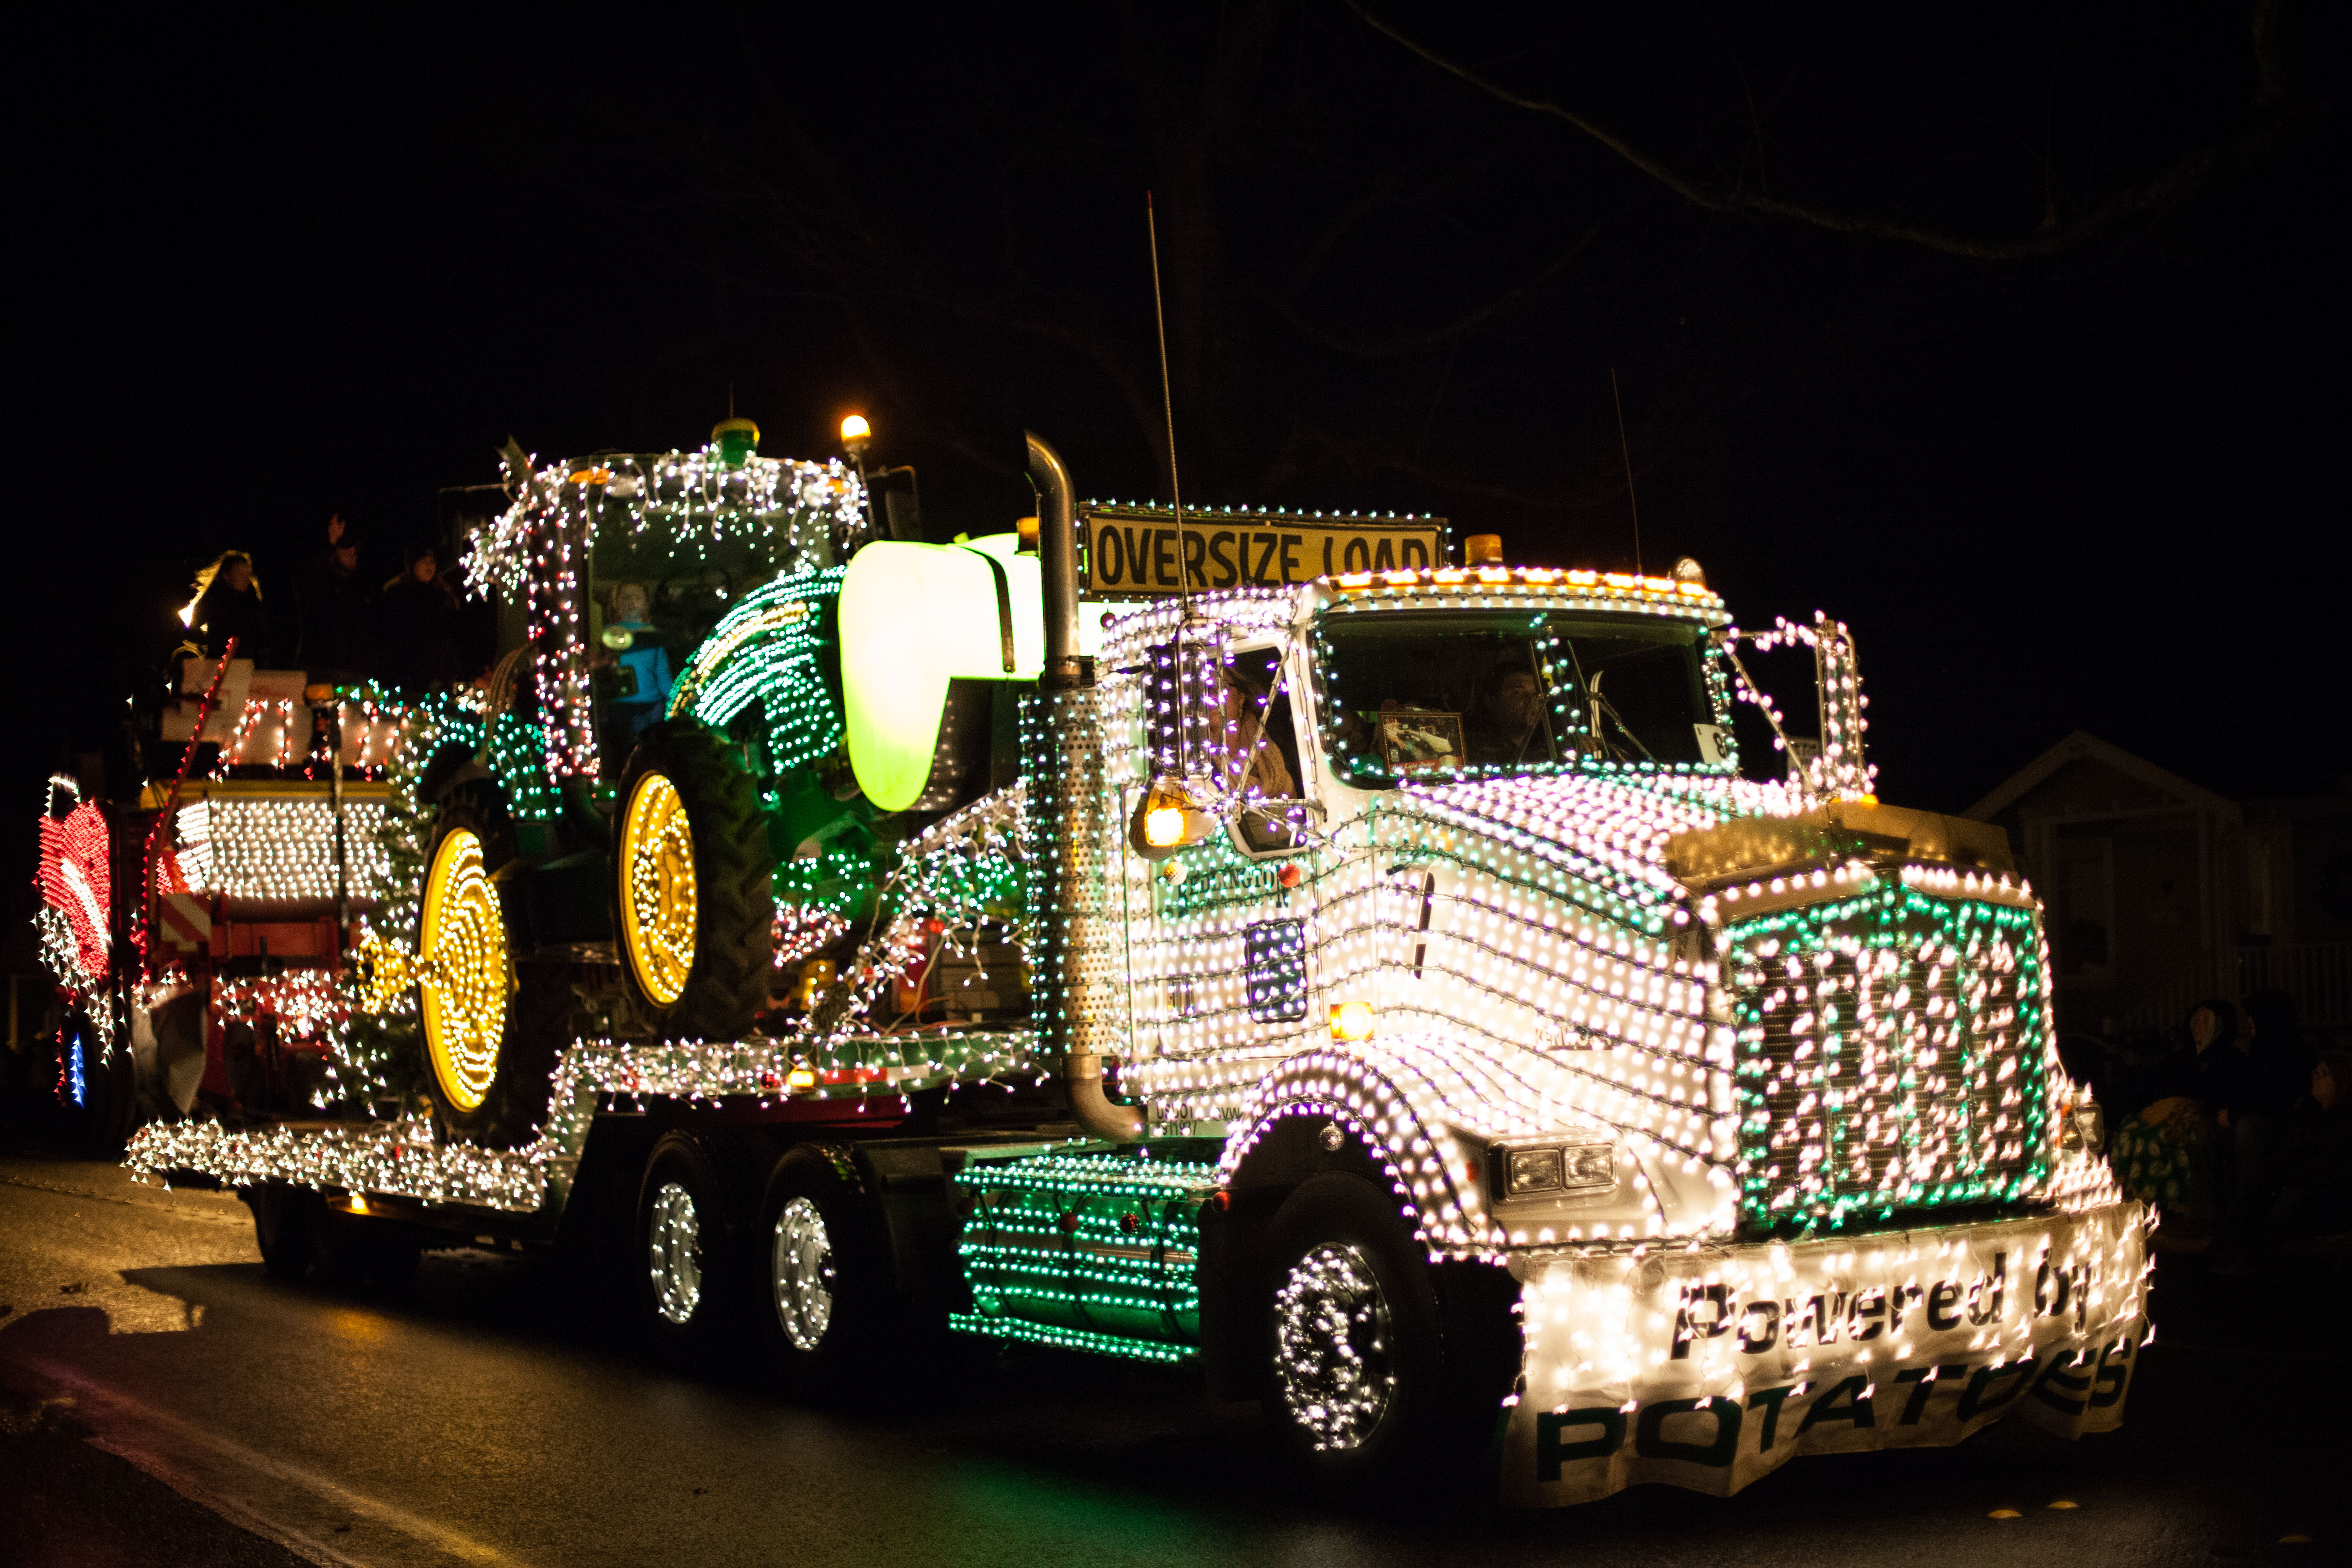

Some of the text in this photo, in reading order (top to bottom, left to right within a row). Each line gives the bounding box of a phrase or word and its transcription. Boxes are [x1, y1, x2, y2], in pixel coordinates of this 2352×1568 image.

[1097, 525, 1429, 587] OVERSIZE LOAD
[1534, 1027, 1613, 1046] KENWO
[1211, 1106, 1240, 1120] VW
[1670, 1249, 2092, 1360] Powered by
[1537, 1337, 2132, 1481] POTATOES
